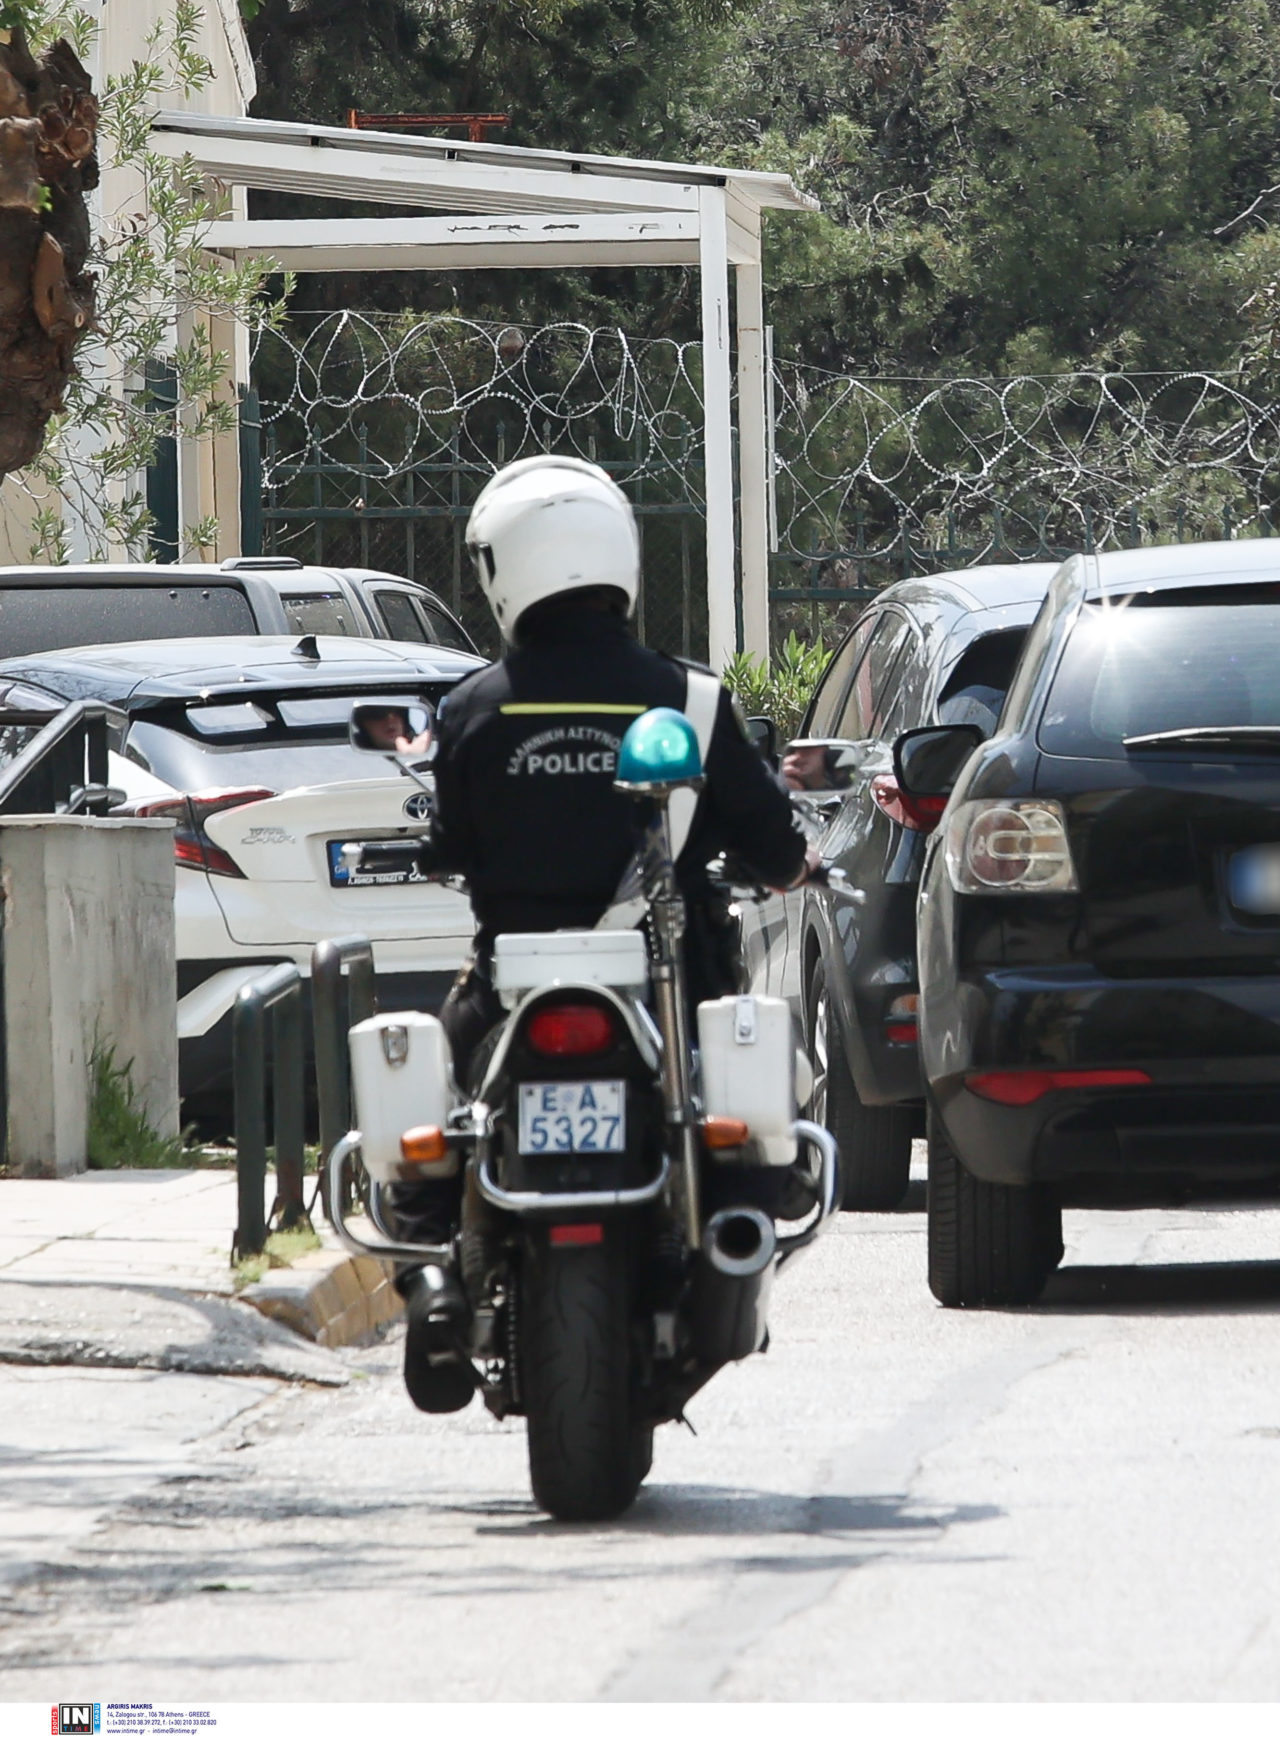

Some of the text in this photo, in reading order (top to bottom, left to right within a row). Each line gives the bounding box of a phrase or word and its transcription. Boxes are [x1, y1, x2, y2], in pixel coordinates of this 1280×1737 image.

[567, 726, 622, 751] ΑΣΤΥΝΟ
[527, 752, 616, 775] POLICE
[531, 1116, 621, 1150] 5327
